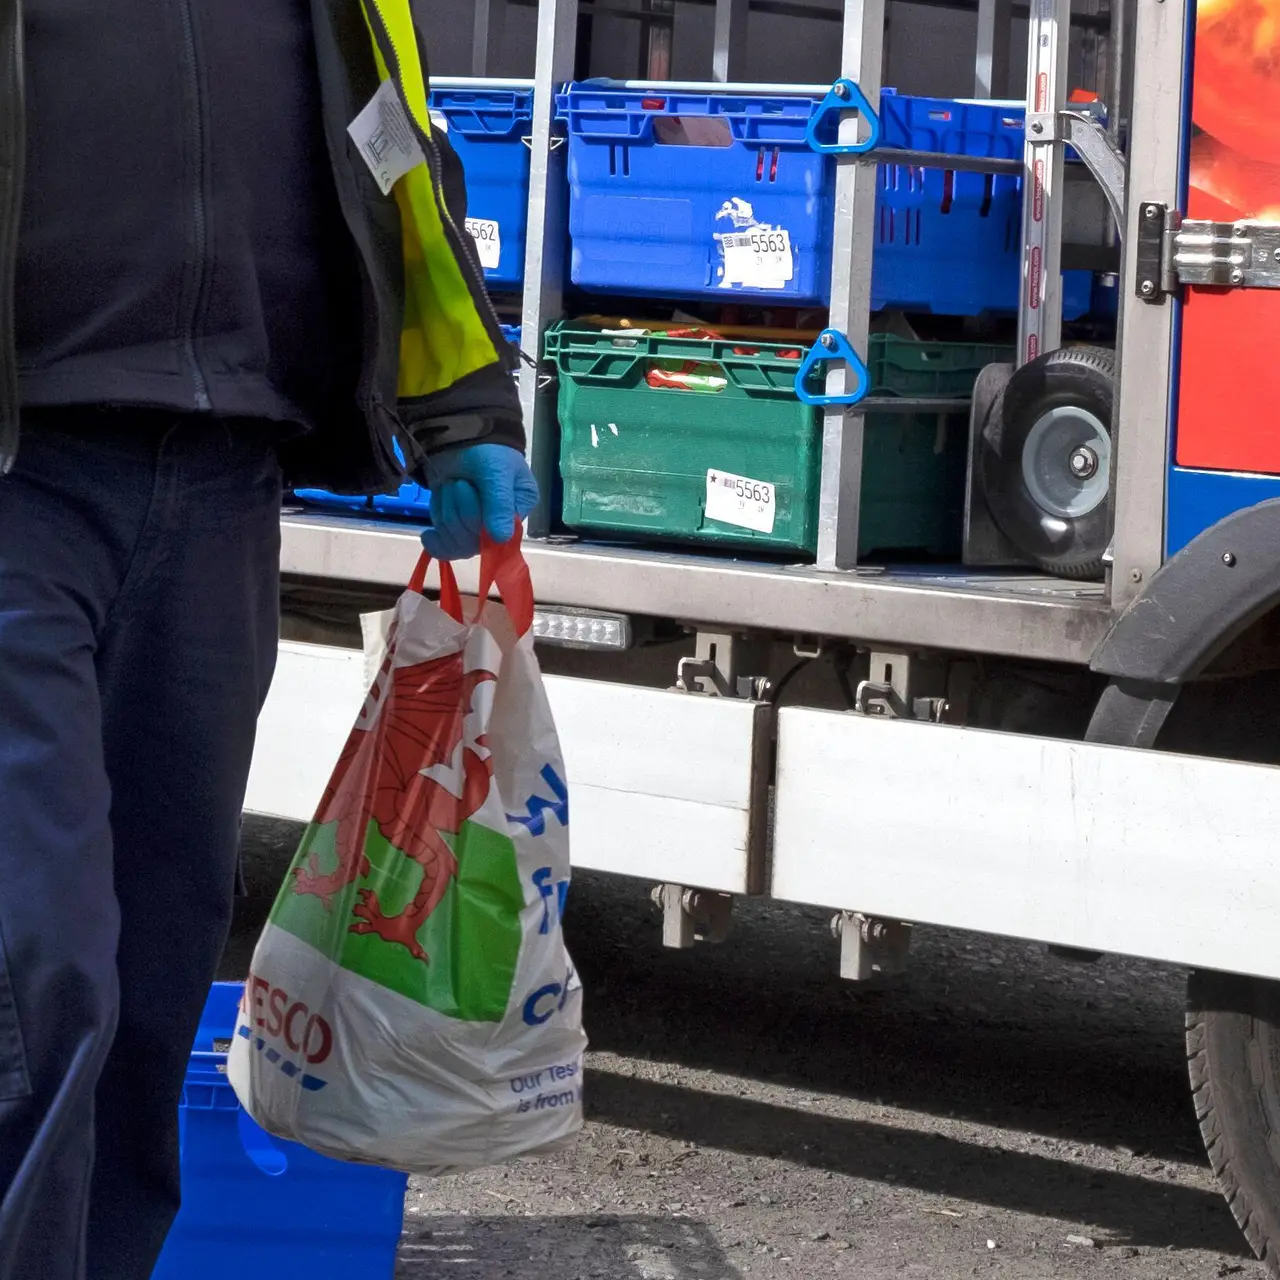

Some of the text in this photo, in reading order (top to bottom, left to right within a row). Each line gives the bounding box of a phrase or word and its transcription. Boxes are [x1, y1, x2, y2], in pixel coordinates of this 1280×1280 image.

[751, 234, 786, 253] 5563
[736, 479, 770, 504] 5563
[510, 1062, 578, 1093] Our Tes
[516, 1098, 530, 1113] is
[534, 1089, 574, 1110] from
